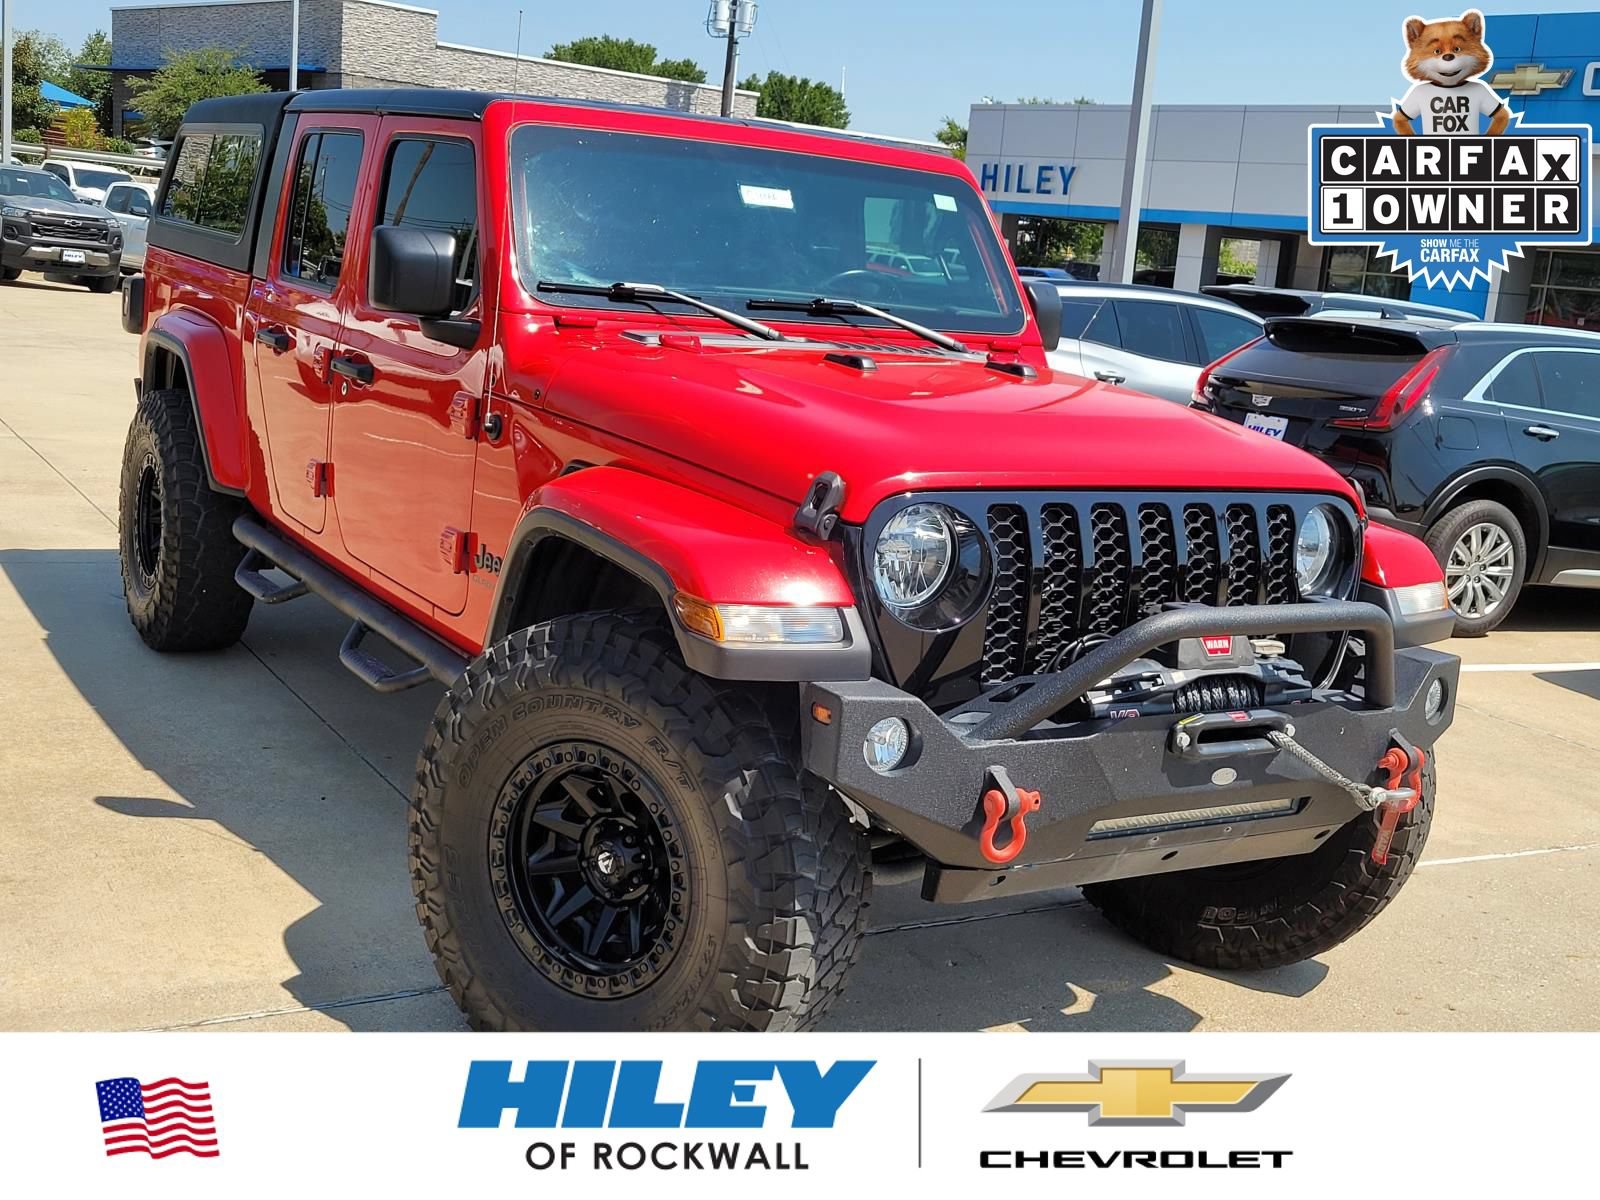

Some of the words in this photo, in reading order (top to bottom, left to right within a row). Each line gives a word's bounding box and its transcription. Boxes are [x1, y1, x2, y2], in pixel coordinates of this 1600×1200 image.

[980, 163, 1077, 196] HILEY
[474, 544, 503, 576] Jee
[1206, 639, 1230, 649] WARN
[458, 719, 510, 788] OPEN
[511, 694, 642, 730] COUNTRY
[647, 736, 696, 793] R/T
